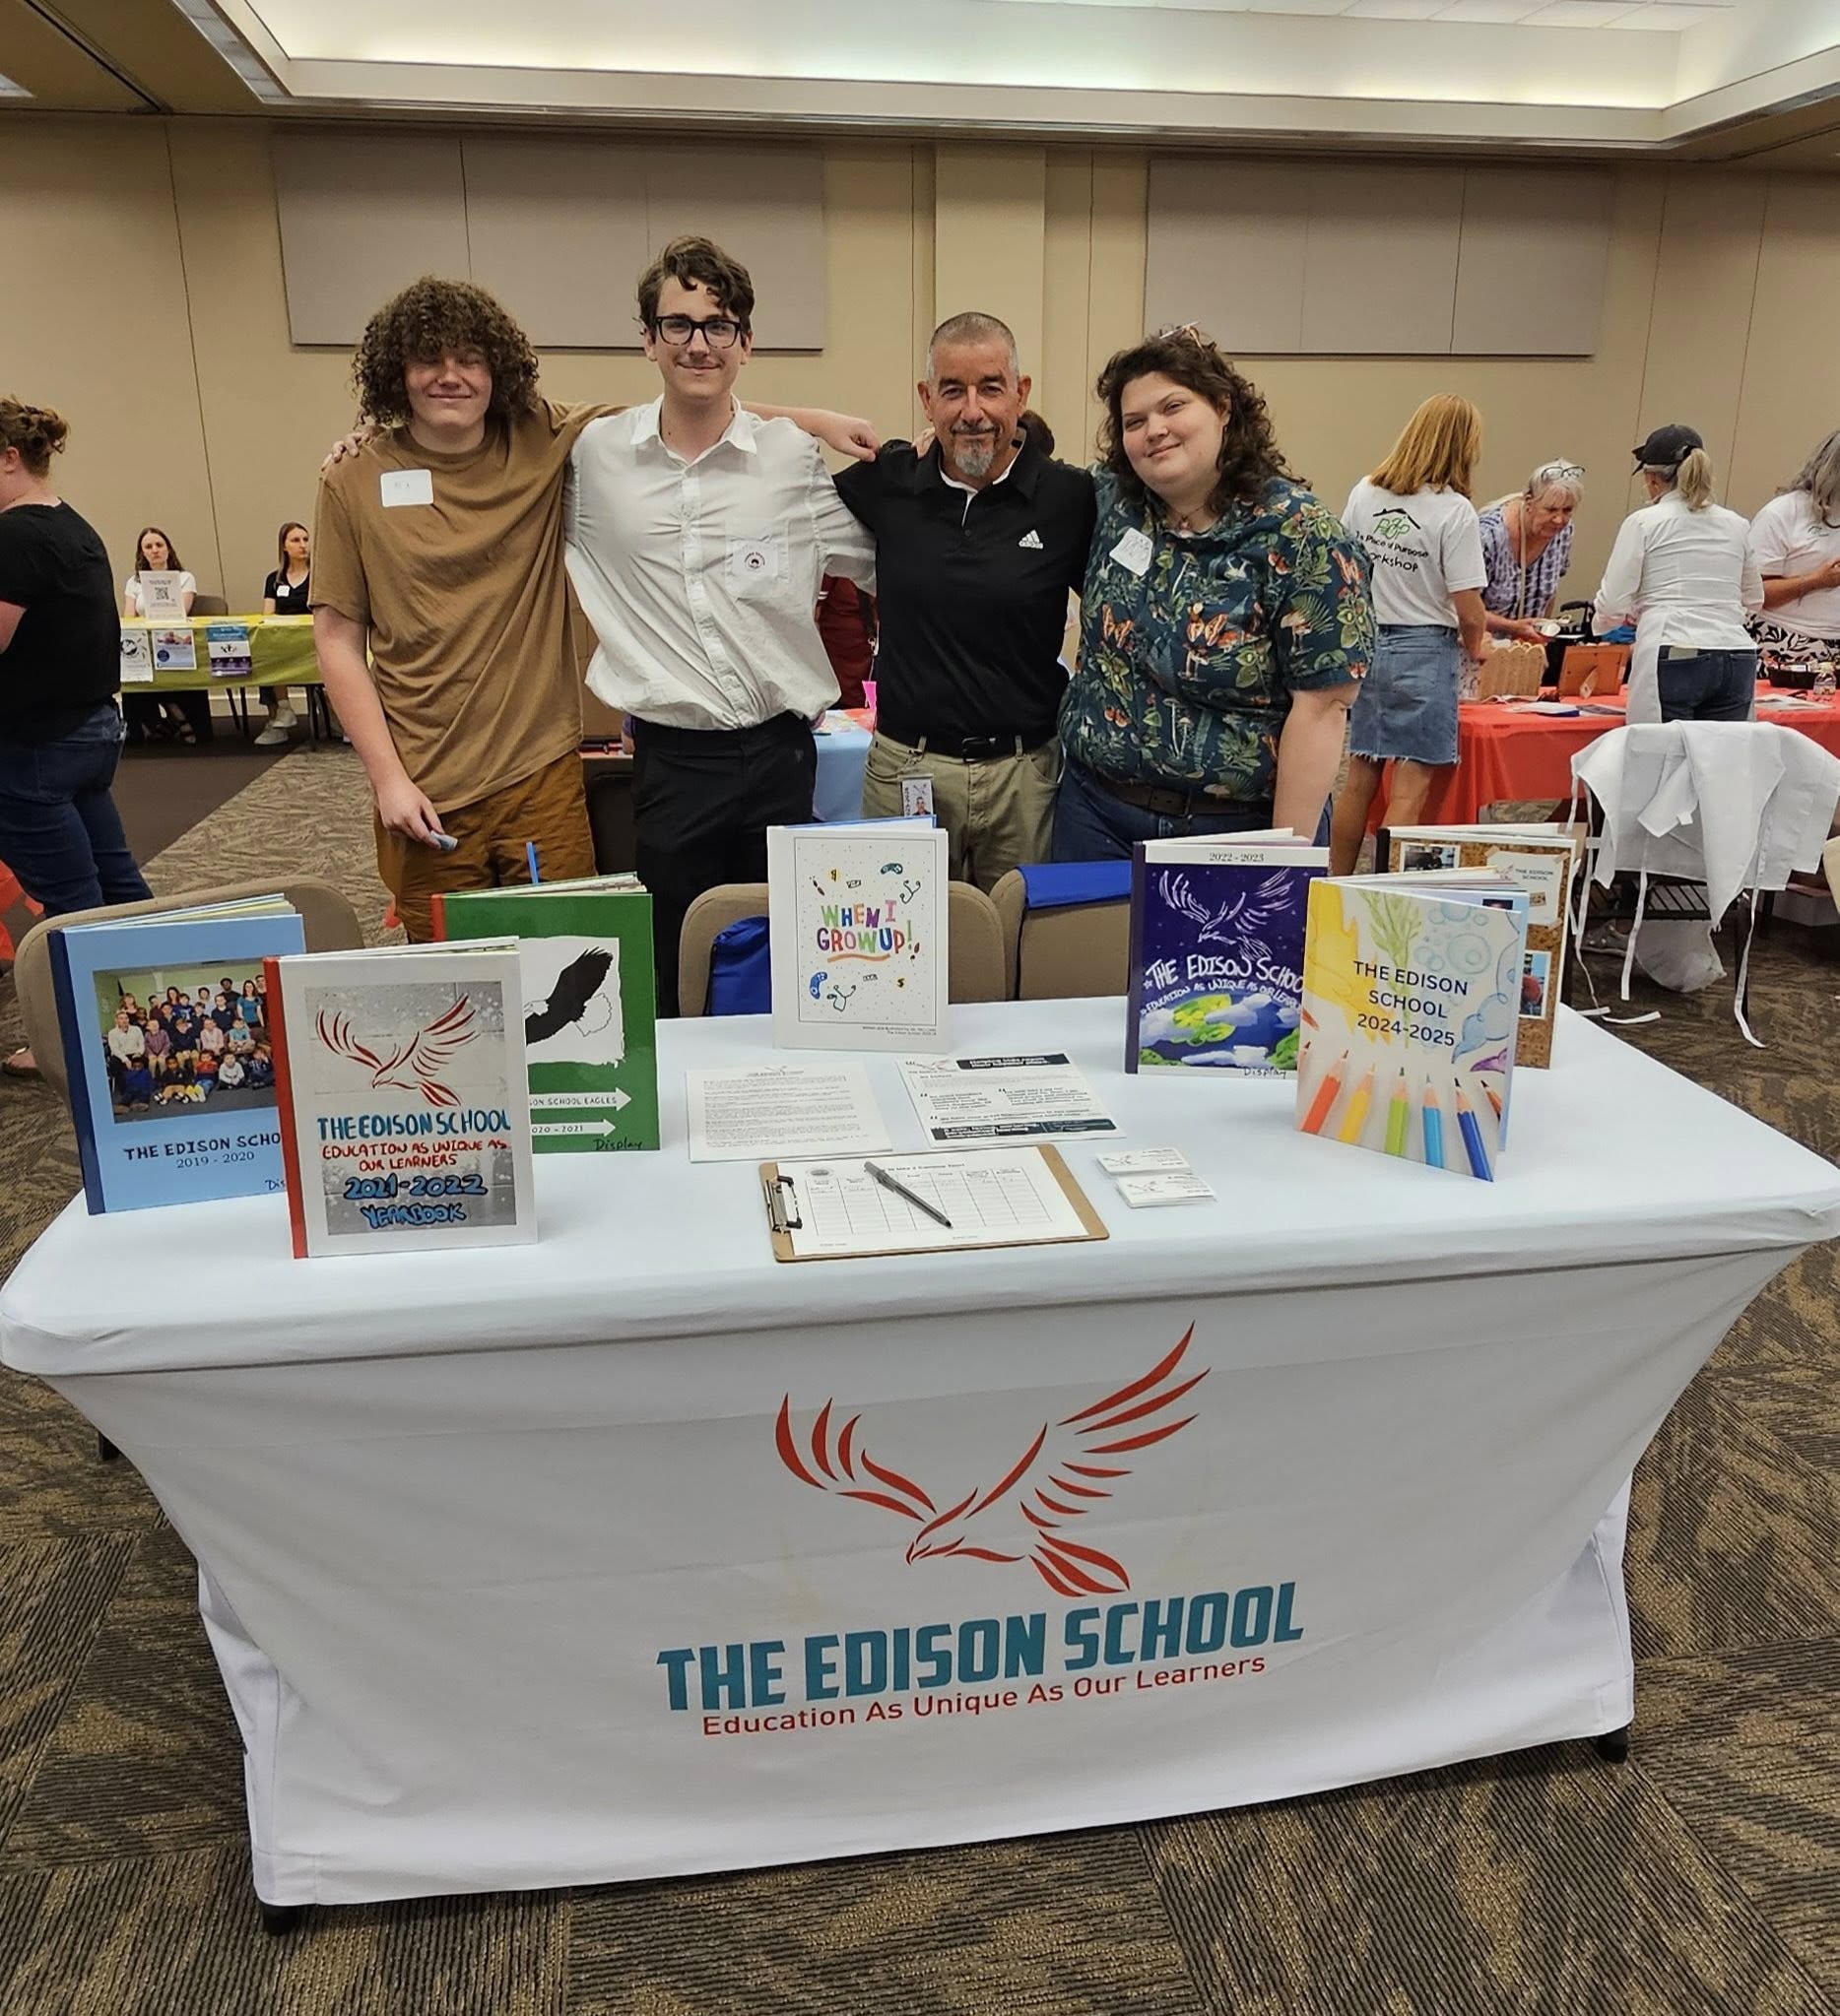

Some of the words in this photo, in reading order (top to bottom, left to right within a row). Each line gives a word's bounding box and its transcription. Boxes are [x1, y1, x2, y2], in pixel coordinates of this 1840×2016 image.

[1365, 534, 1387, 548] Place
[1394, 543, 1429, 558] Purpose
[1369, 553, 1419, 572] orkshop
[821, 903, 881, 929] WHEN
[884, 899, 897, 923] I
[1146, 958, 1179, 990] THE
[1186, 953, 1253, 980] EDISON
[1255, 955, 1304, 994] SCHOO
[1353, 960, 1390, 982] THE
[1394, 969, 1469, 996] EDISON
[1146, 985, 1191, 1012] EDUCATION
[1367, 990, 1448, 1019] SCHOOL
[1356, 1012, 1456, 1047] 2024-2025
[1244, 1066, 1286, 1080] Display
[529, 1097, 544, 1106] ON
[548, 1096, 581, 1106] SCHOOL
[583, 1096, 618, 1105] EAGLES
[435, 1109, 511, 1137] SCHOOL
[561, 1125, 583, 1134] 2021
[123, 1144, 160, 1161] THE
[164, 1138, 230, 1157] EDISON
[236, 1133, 281, 1148] SCHO
[322, 1142, 408, 1160] EDUCATION
[411, 1141, 429, 1154] AS
[432, 1138, 484, 1153] UNIQUE
[488, 1138, 508, 1150] AS
[593, 1137, 643, 1151] Display
[176, 1156, 209, 1169] 2019
[223, 1151, 255, 1164] 2020
[359, 1158, 385, 1173] OUR
[389, 1153, 458, 1170] LEARNERS
[265, 1179, 286, 1191] Dis
[344, 1173, 489, 1201] 2021-2022
[361, 1203, 467, 1229] YEARBOOK
[656, 1640, 786, 1712] THE
[804, 1612, 1047, 1702] EDISON
[1064, 1582, 1304, 1671] SCHOOL
[703, 1707, 855, 1736] Education
[865, 1701, 903, 1723] As
[913, 1690, 1019, 1717] Unique
[1027, 1683, 1064, 1704] As
[1074, 1676, 1127, 1697] Our
[1137, 1657, 1266, 1690] Learners
